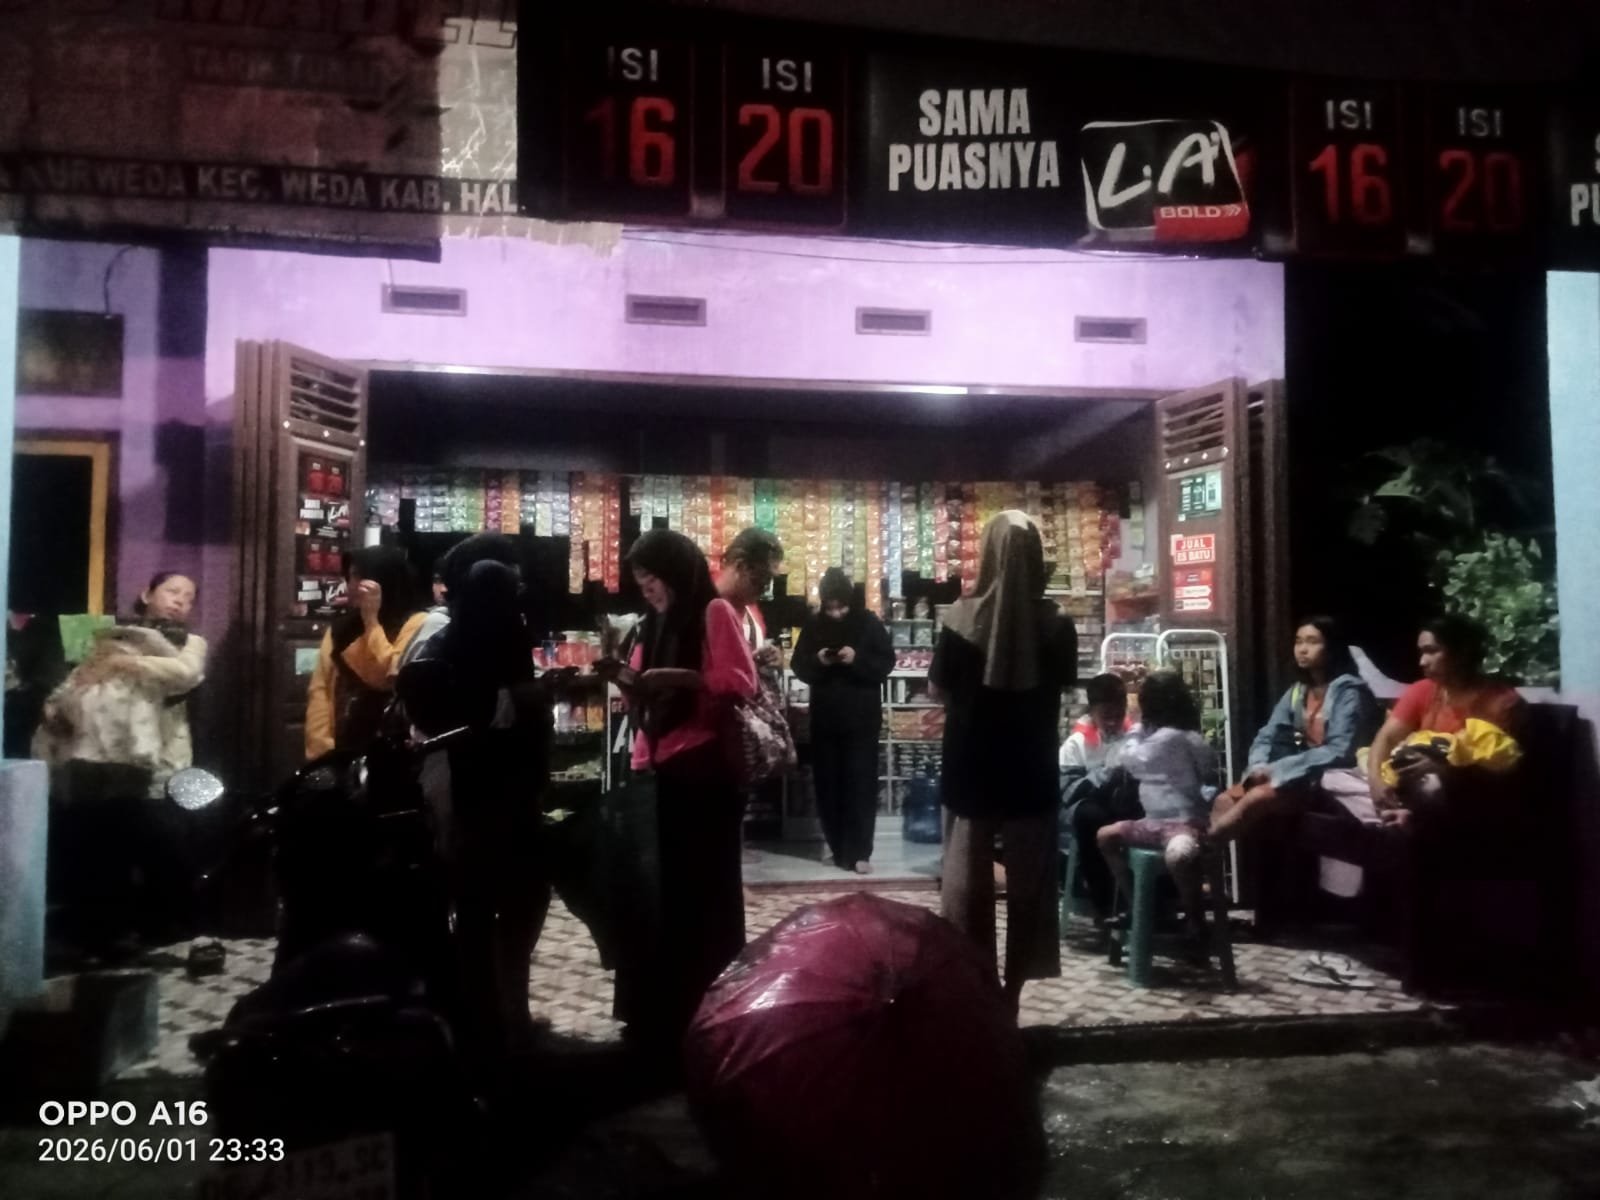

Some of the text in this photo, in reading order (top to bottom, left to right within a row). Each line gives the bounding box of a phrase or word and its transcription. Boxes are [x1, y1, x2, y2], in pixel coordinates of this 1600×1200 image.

[608, 45, 660, 82] ISI
[761, 57, 814, 94] ISI
[918, 87, 1031, 137] SAMA
[1325, 99, 1375, 131] ISI
[1457, 106, 1504, 140] ISI
[584, 95, 677, 190] 16
[737, 103, 834, 196] 20
[888, 140, 1062, 192] PUASNYA
[199, 164, 271, 202] KEC.
[281, 168, 371, 207] WEDA
[380, 178, 451, 213] KAB.
[1308, 142, 1393, 227] 16
[1437, 149, 1522, 233] 20
[1160, 205, 1222, 218] BOLD
